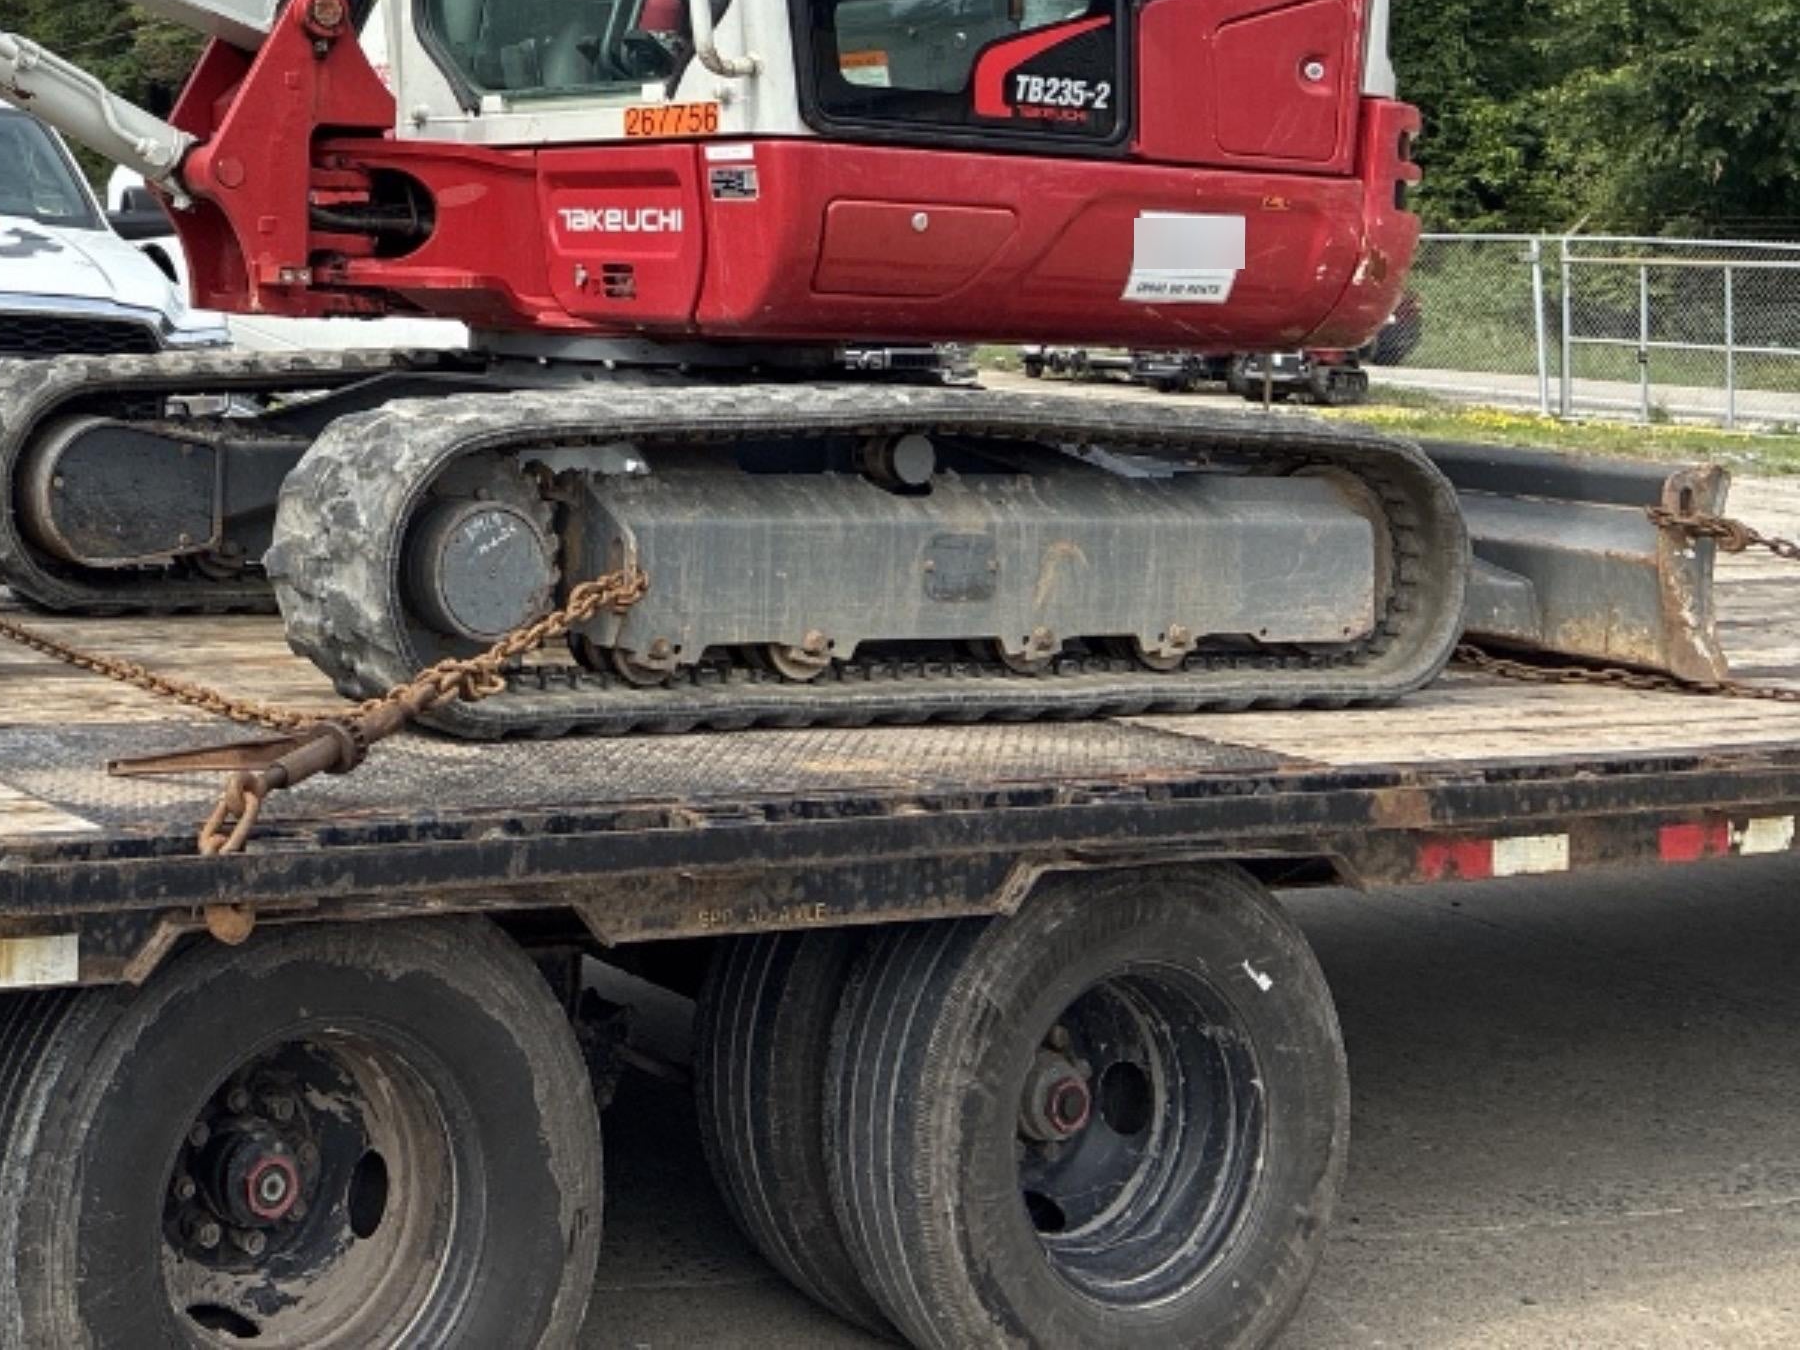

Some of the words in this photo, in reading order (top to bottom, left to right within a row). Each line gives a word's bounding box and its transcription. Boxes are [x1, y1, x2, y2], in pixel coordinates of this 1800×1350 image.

[1016, 74, 1111, 109] TB235-2
[625, 102, 718, 136] 267756
[557, 208, 683, 232] TAKEUCHI
